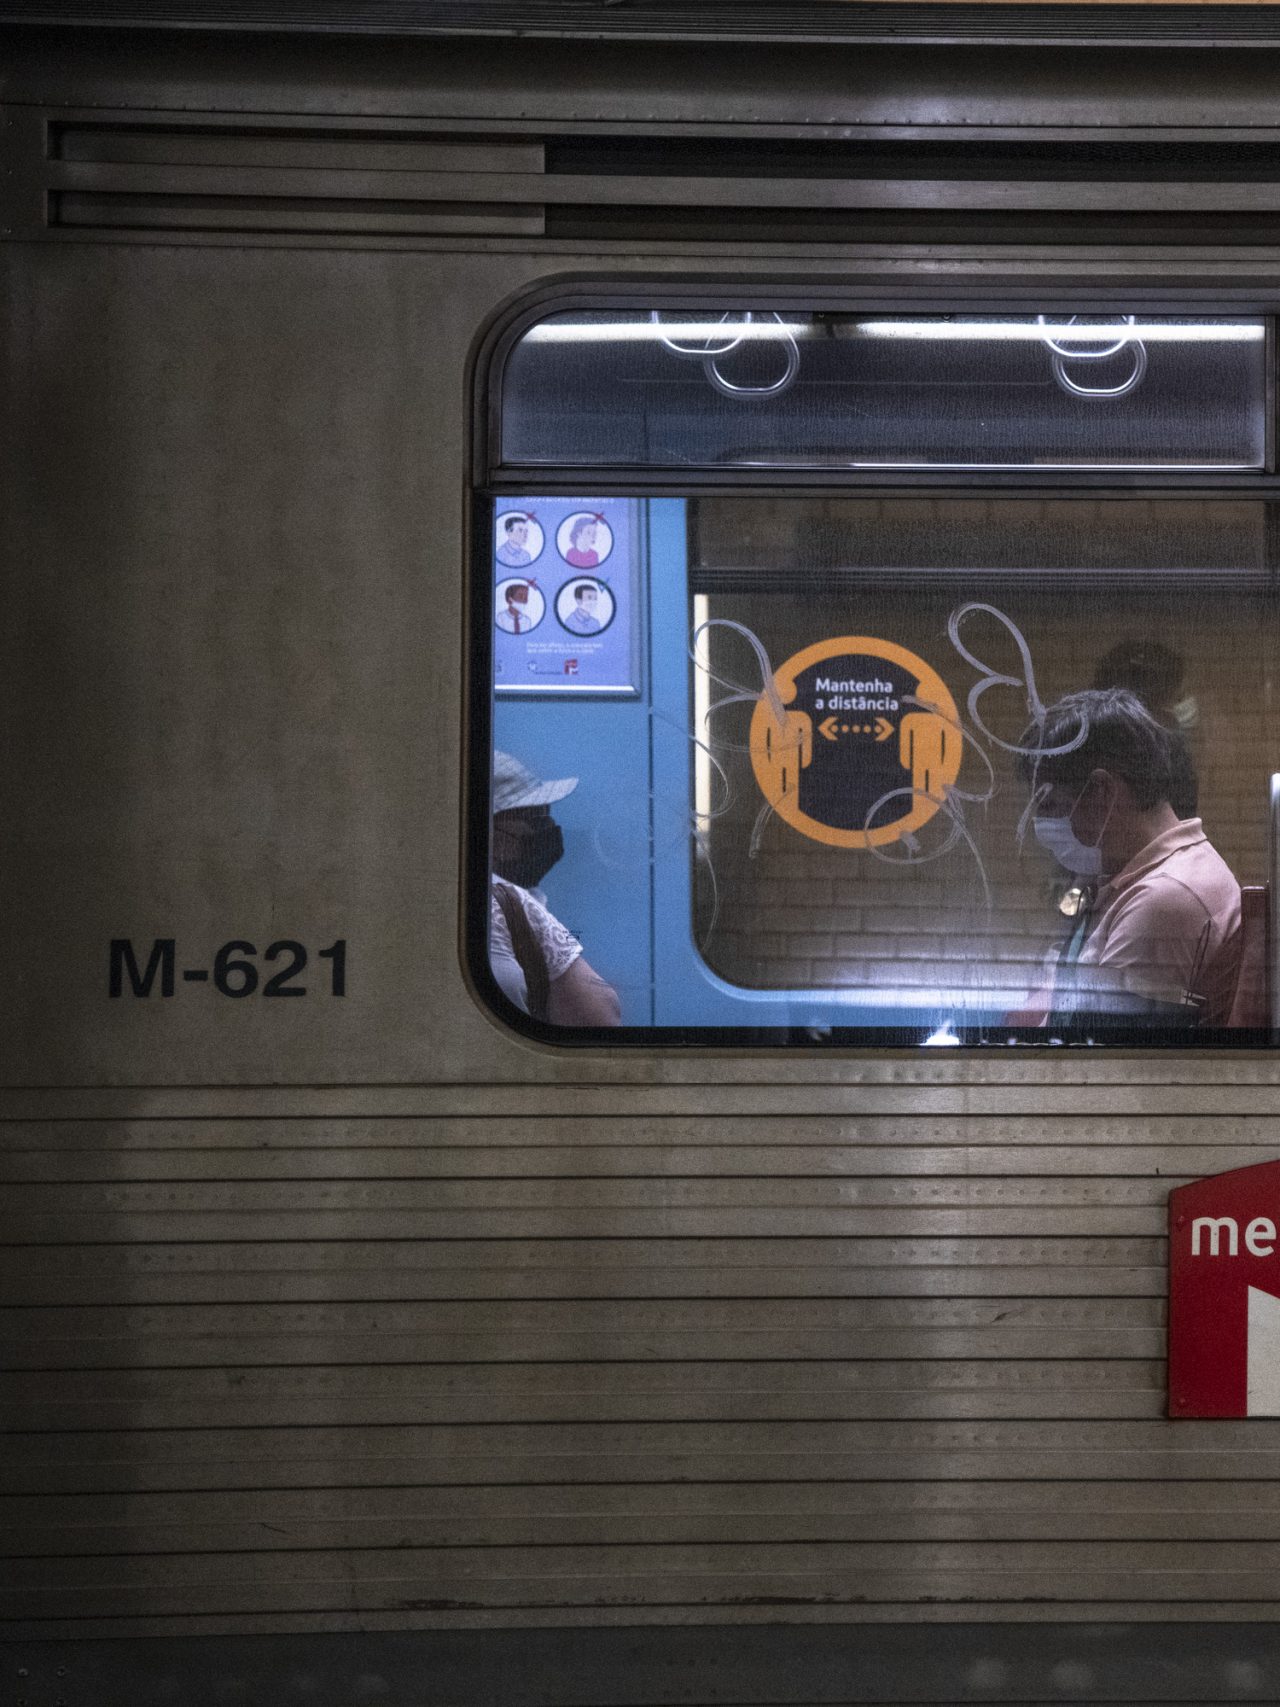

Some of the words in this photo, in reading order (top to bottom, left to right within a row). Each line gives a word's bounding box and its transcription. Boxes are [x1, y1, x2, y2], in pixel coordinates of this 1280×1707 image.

[815, 678, 893, 693] Mantenha
[815, 698, 824, 710] a
[828, 695, 899, 711] distância
[109, 938, 347, 998] M-621
